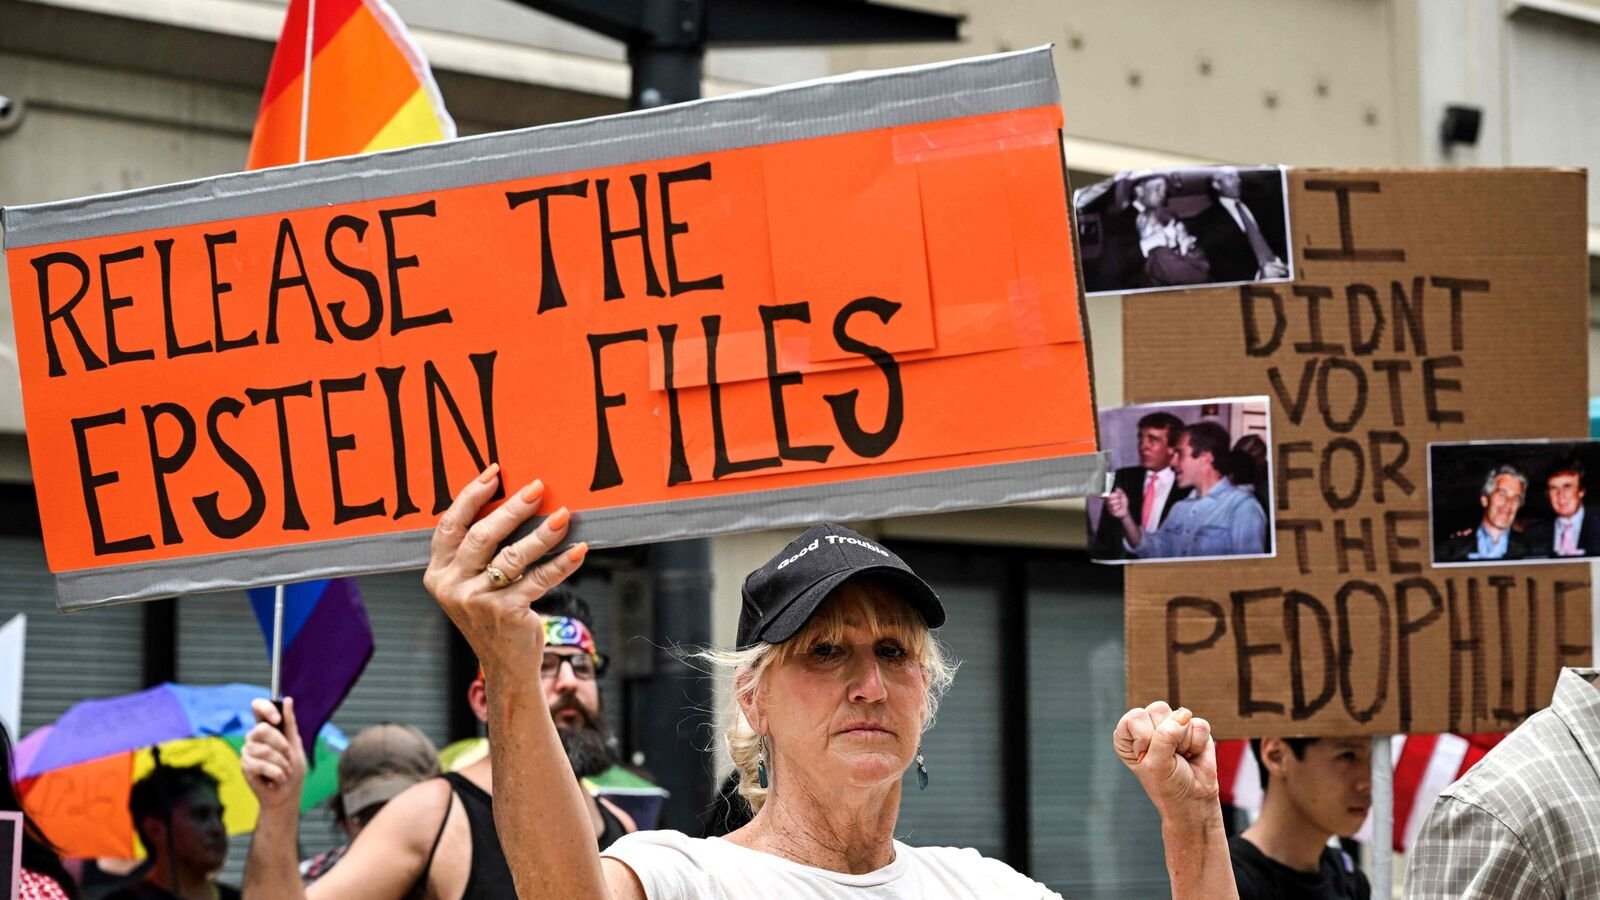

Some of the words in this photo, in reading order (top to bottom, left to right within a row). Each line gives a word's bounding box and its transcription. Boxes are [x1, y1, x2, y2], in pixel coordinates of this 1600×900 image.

[1304, 180, 1406, 262] I
[30, 200, 453, 377] RELEASE
[505, 161, 725, 314] THE
[1239, 276, 1491, 357] DIDNT
[71, 351, 506, 556] EPSTEIN
[586, 296, 905, 492] FILES
[1267, 356, 1465, 433] VOTE
[1277, 430, 1416, 510] FOR
[777, 539, 820, 570] Good
[825, 535, 889, 558] Trouble
[1275, 510, 1429, 574] THE
